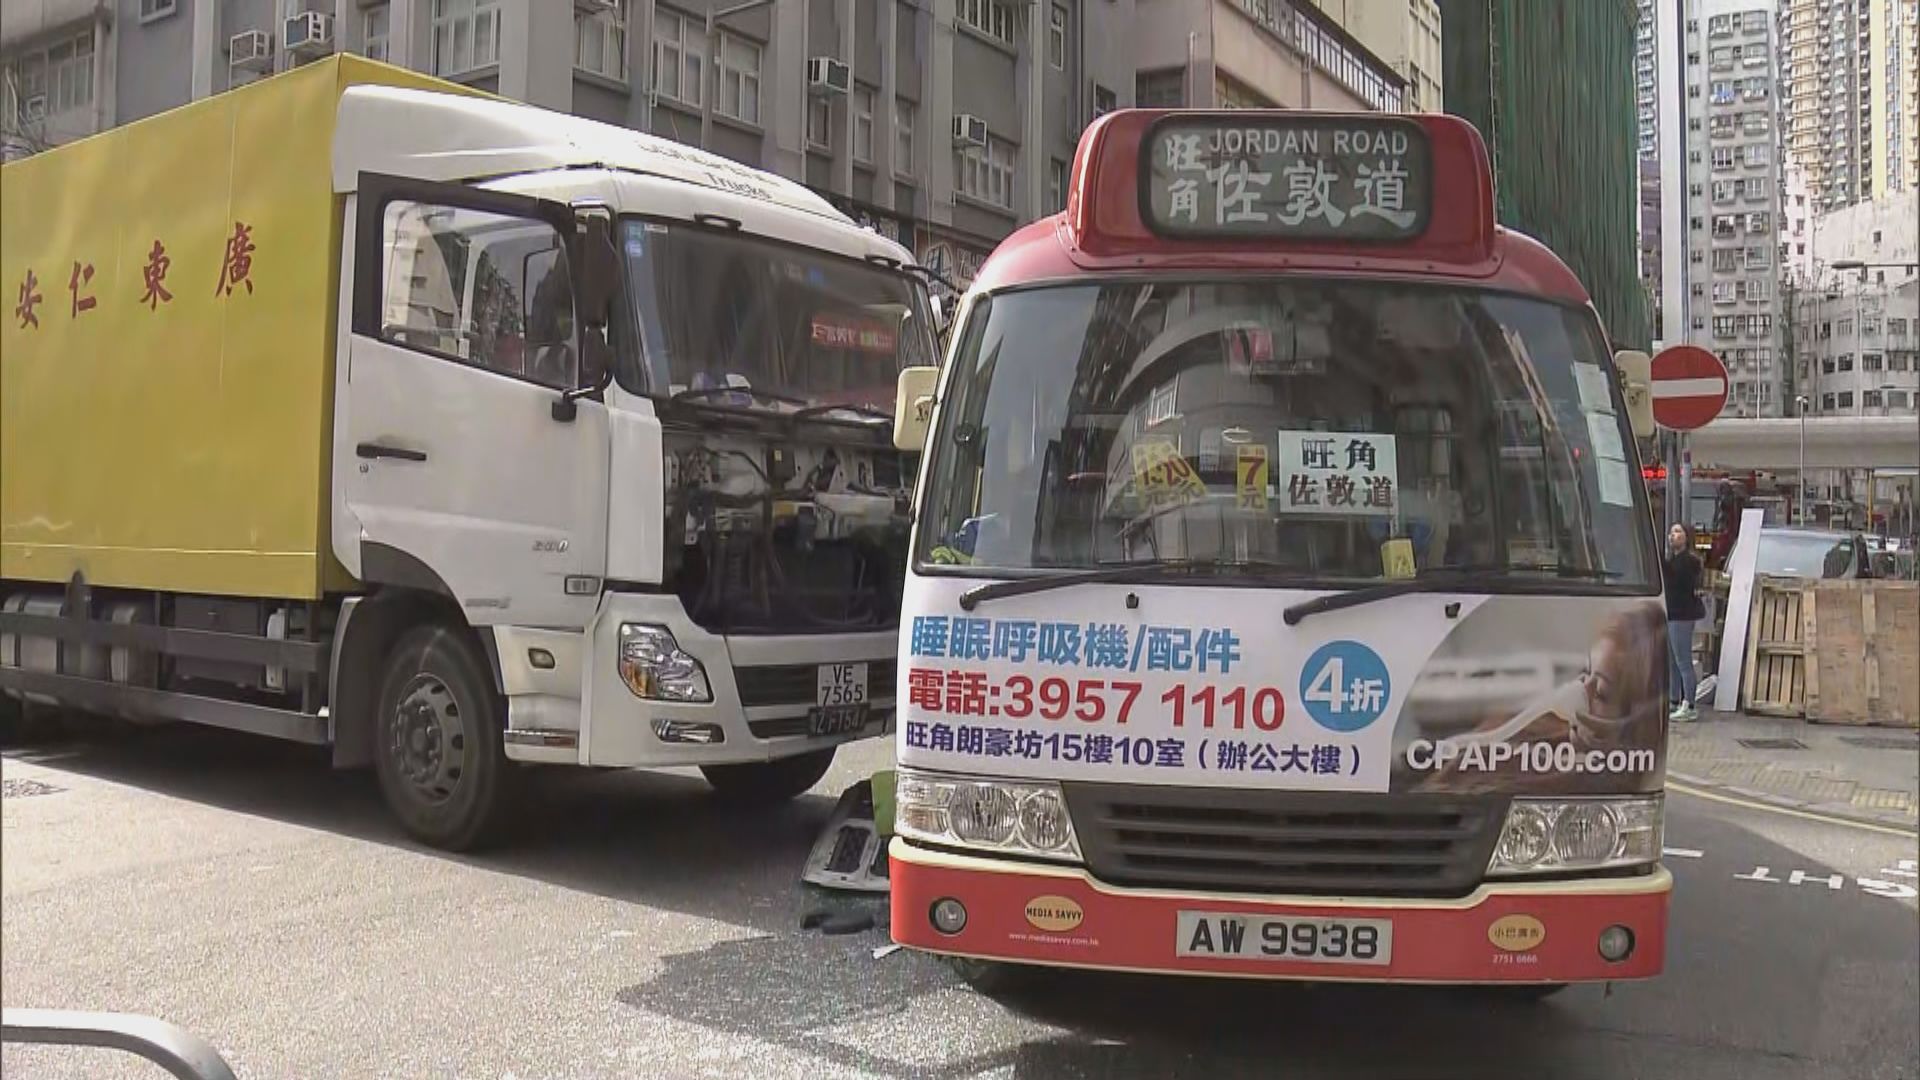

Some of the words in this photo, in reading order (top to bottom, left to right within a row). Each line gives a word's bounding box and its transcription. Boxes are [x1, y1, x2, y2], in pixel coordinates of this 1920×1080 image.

[1209, 129, 1318, 155] JORDAN
[1334, 130, 1408, 155] ROAD
[1165, 134, 1206, 223] 旺角
[1206, 160, 1416, 228] 佐敦道
[1240, 456, 1265, 485] 7
[1302, 438, 1378, 471] 旺角
[1288, 473, 1394, 508] 佐敦道
[910, 616, 1241, 673] 睡眠呼吸機/配件
[833, 666, 853, 684] VE
[1304, 657, 1384, 714] 4折
[821, 684, 863, 707] 7565
[1161, 684, 1285, 731] 1110
[1406, 739, 1655, 773] CPAP100.com
[1026, 908, 1052, 918] MEDIA
[1055, 910, 1082, 920] SAVVY
[1189, 918, 1245, 953] AW
[1261, 922, 1378, 959] 9938
